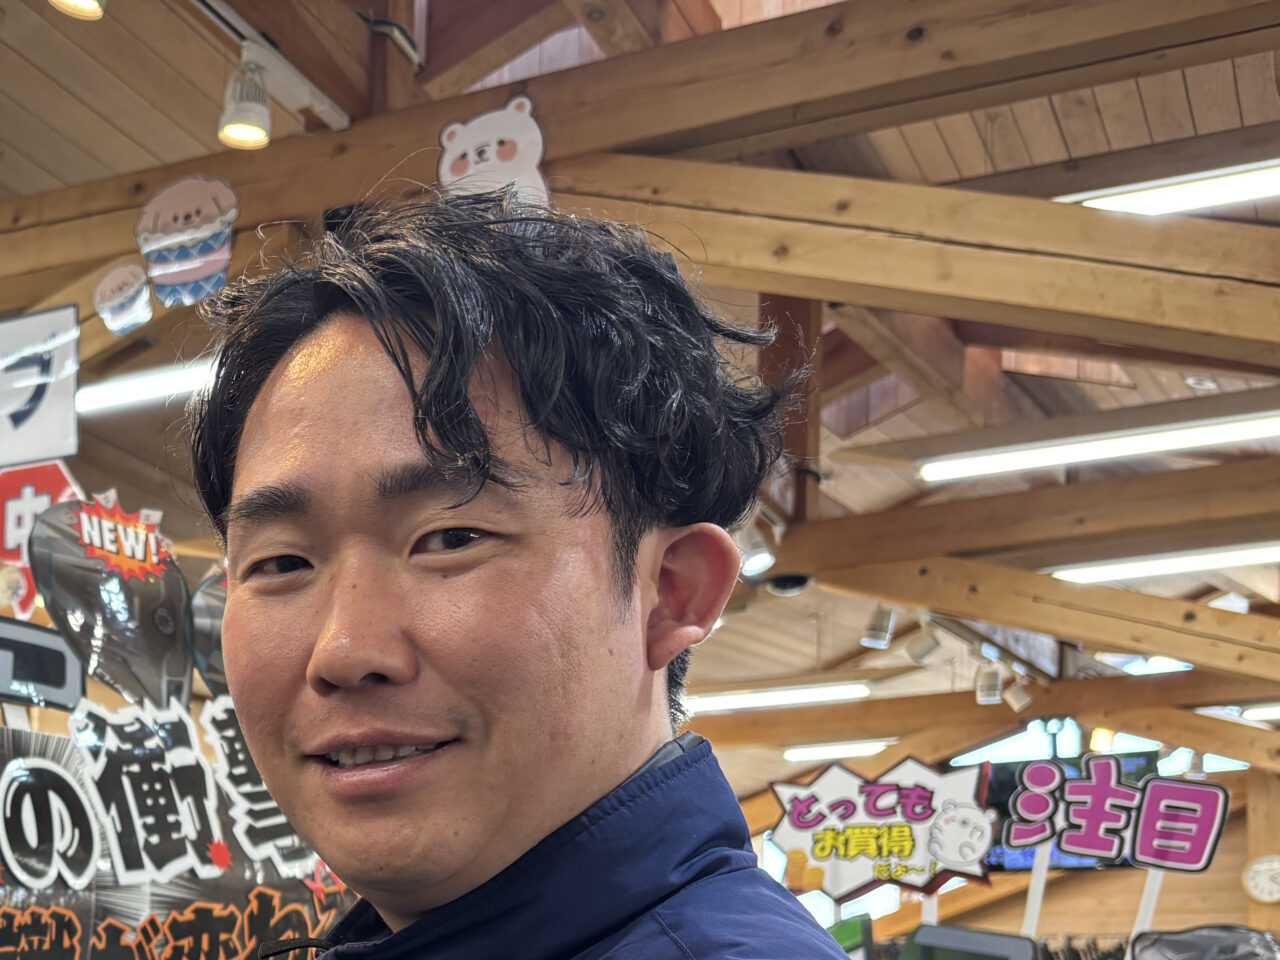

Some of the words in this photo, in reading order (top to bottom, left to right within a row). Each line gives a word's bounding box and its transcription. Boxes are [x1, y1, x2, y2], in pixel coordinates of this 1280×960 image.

[80, 511, 162, 561] NEW!
[790, 783, 936, 829] とっても
[1007, 756, 1228, 872] 注目
[813, 823, 915, 860] お買得
